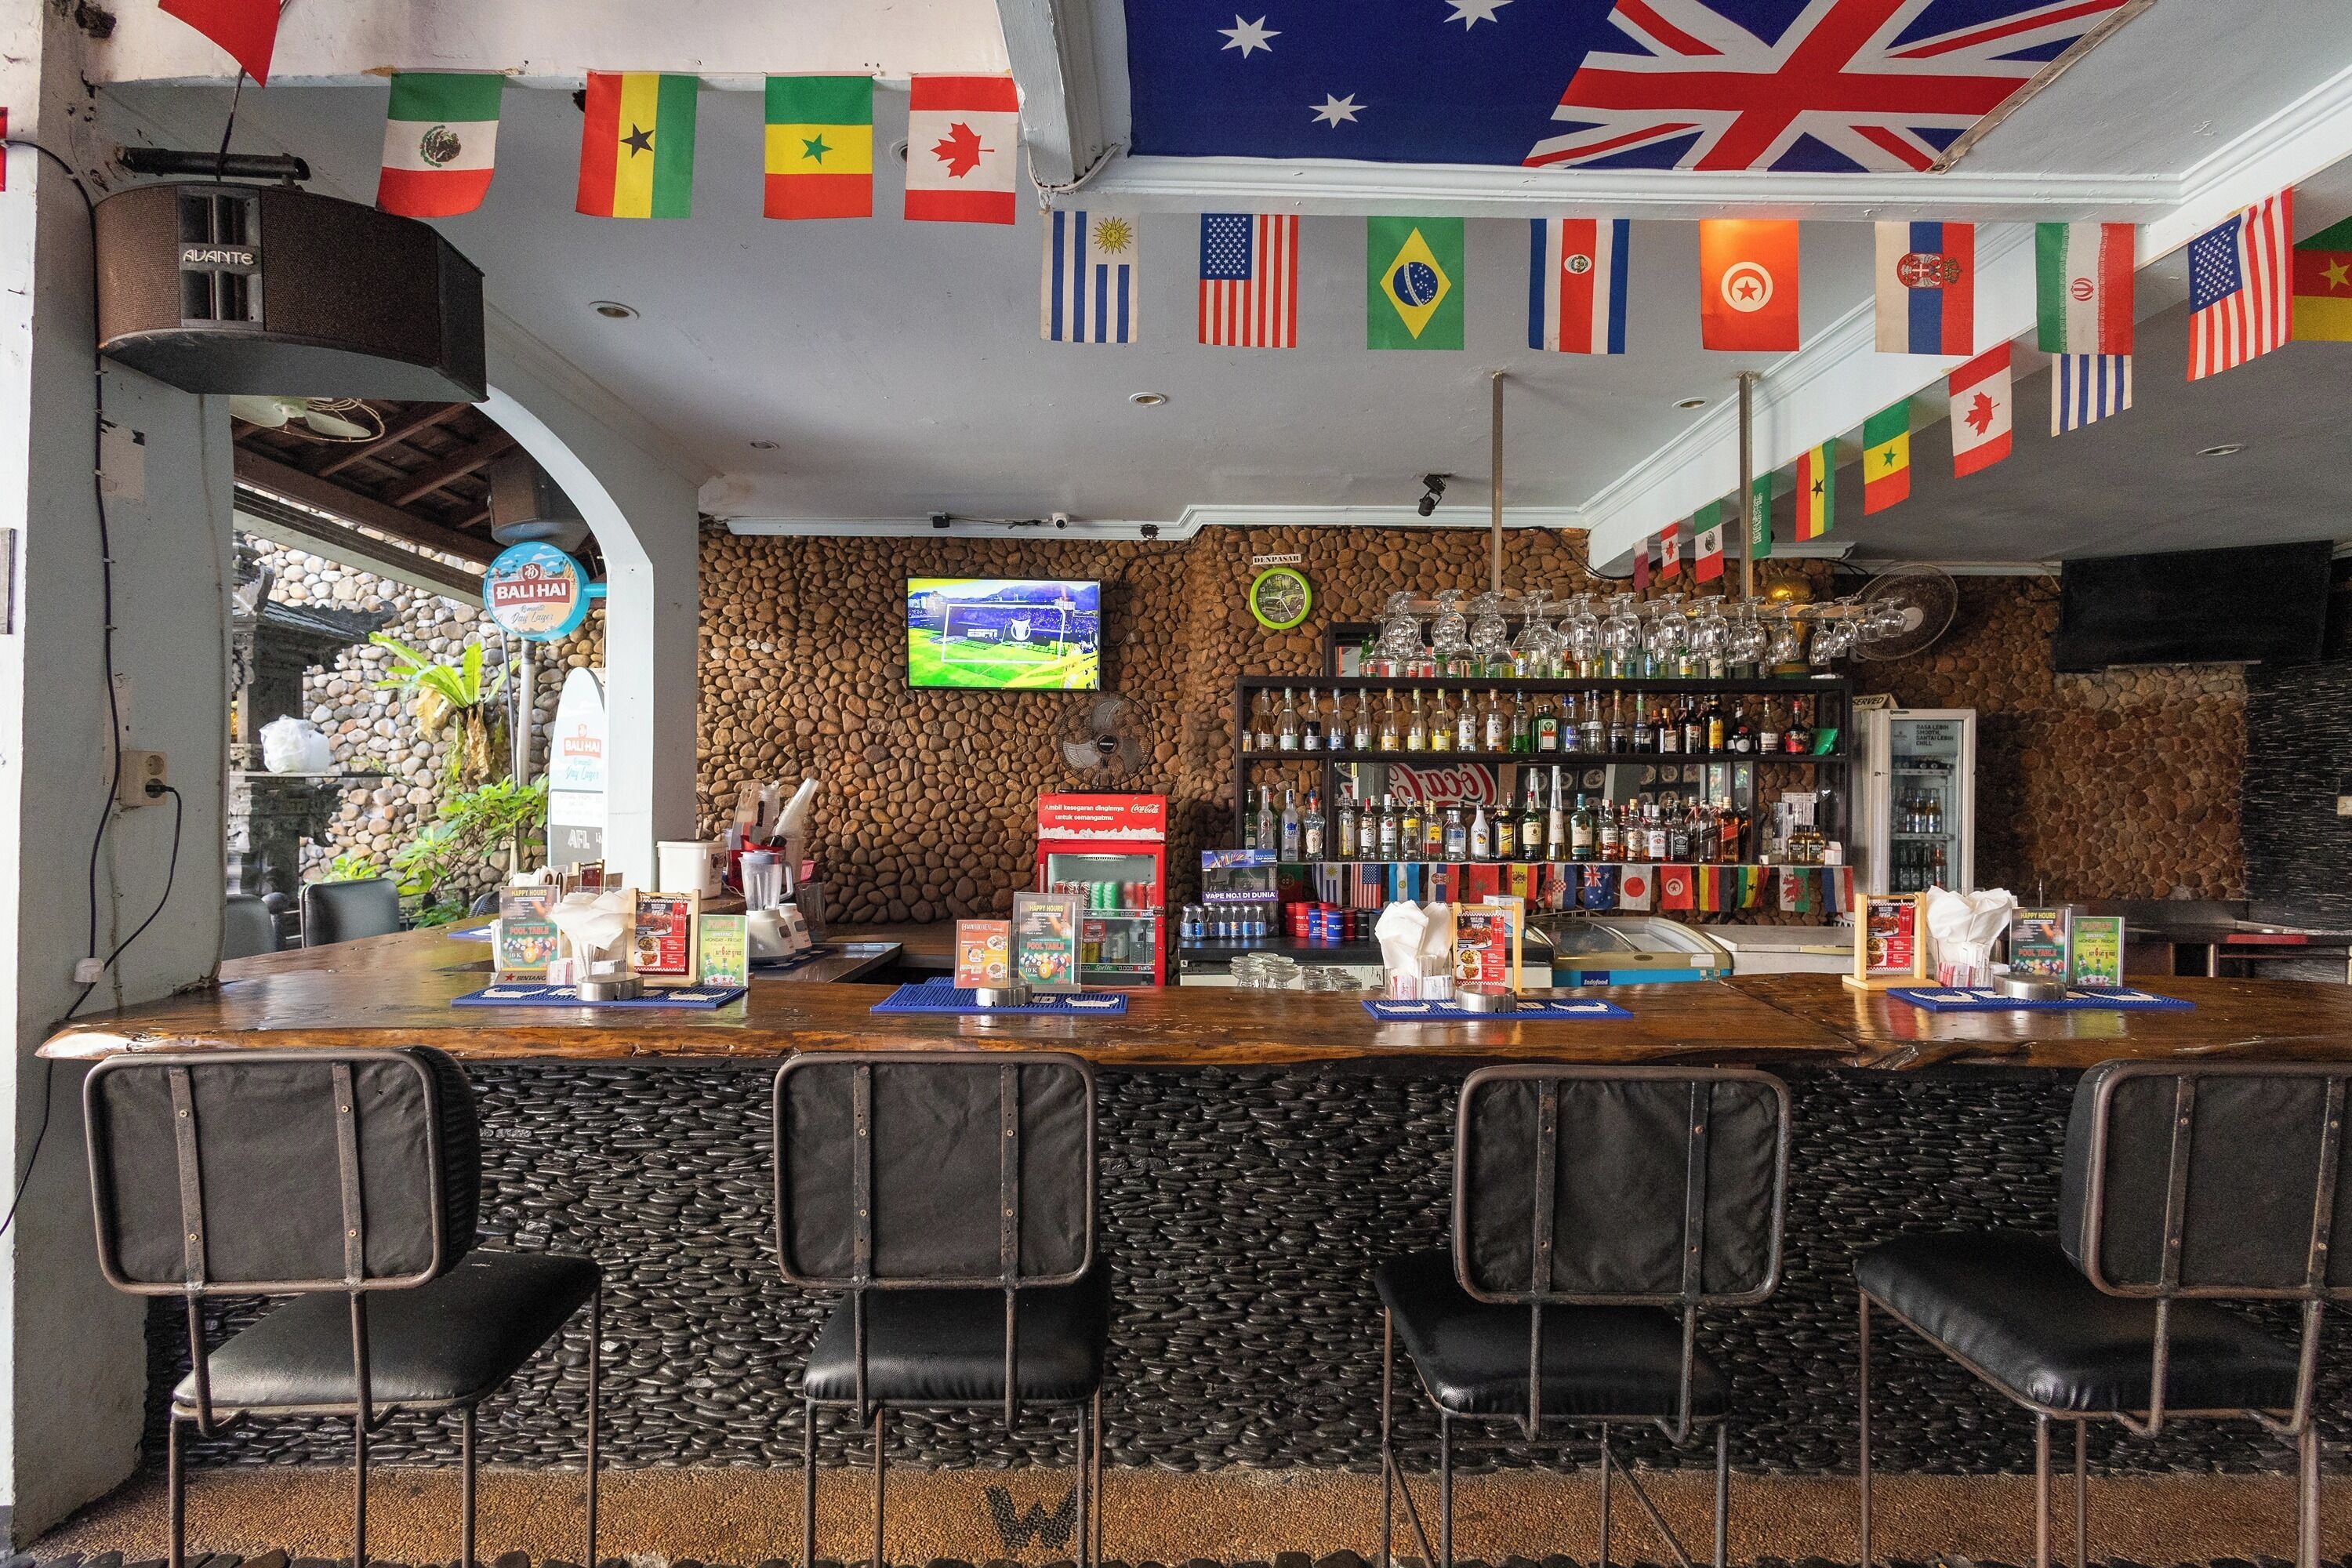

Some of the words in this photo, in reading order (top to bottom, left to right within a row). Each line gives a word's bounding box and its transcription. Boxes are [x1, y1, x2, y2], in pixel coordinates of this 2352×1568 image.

[183, 249, 253, 265] AVANTE
[1254, 555, 1299, 564] DENPASAR
[496, 585, 534, 599] BALI
[536, 583, 566, 597] HAI
[967, 629, 997, 638] ESPN
[564, 740, 584, 752] BALI
[584, 741, 600, 753] HAI
[567, 829, 590, 849] AFL
[984, 1486, 1091, 1550] W
